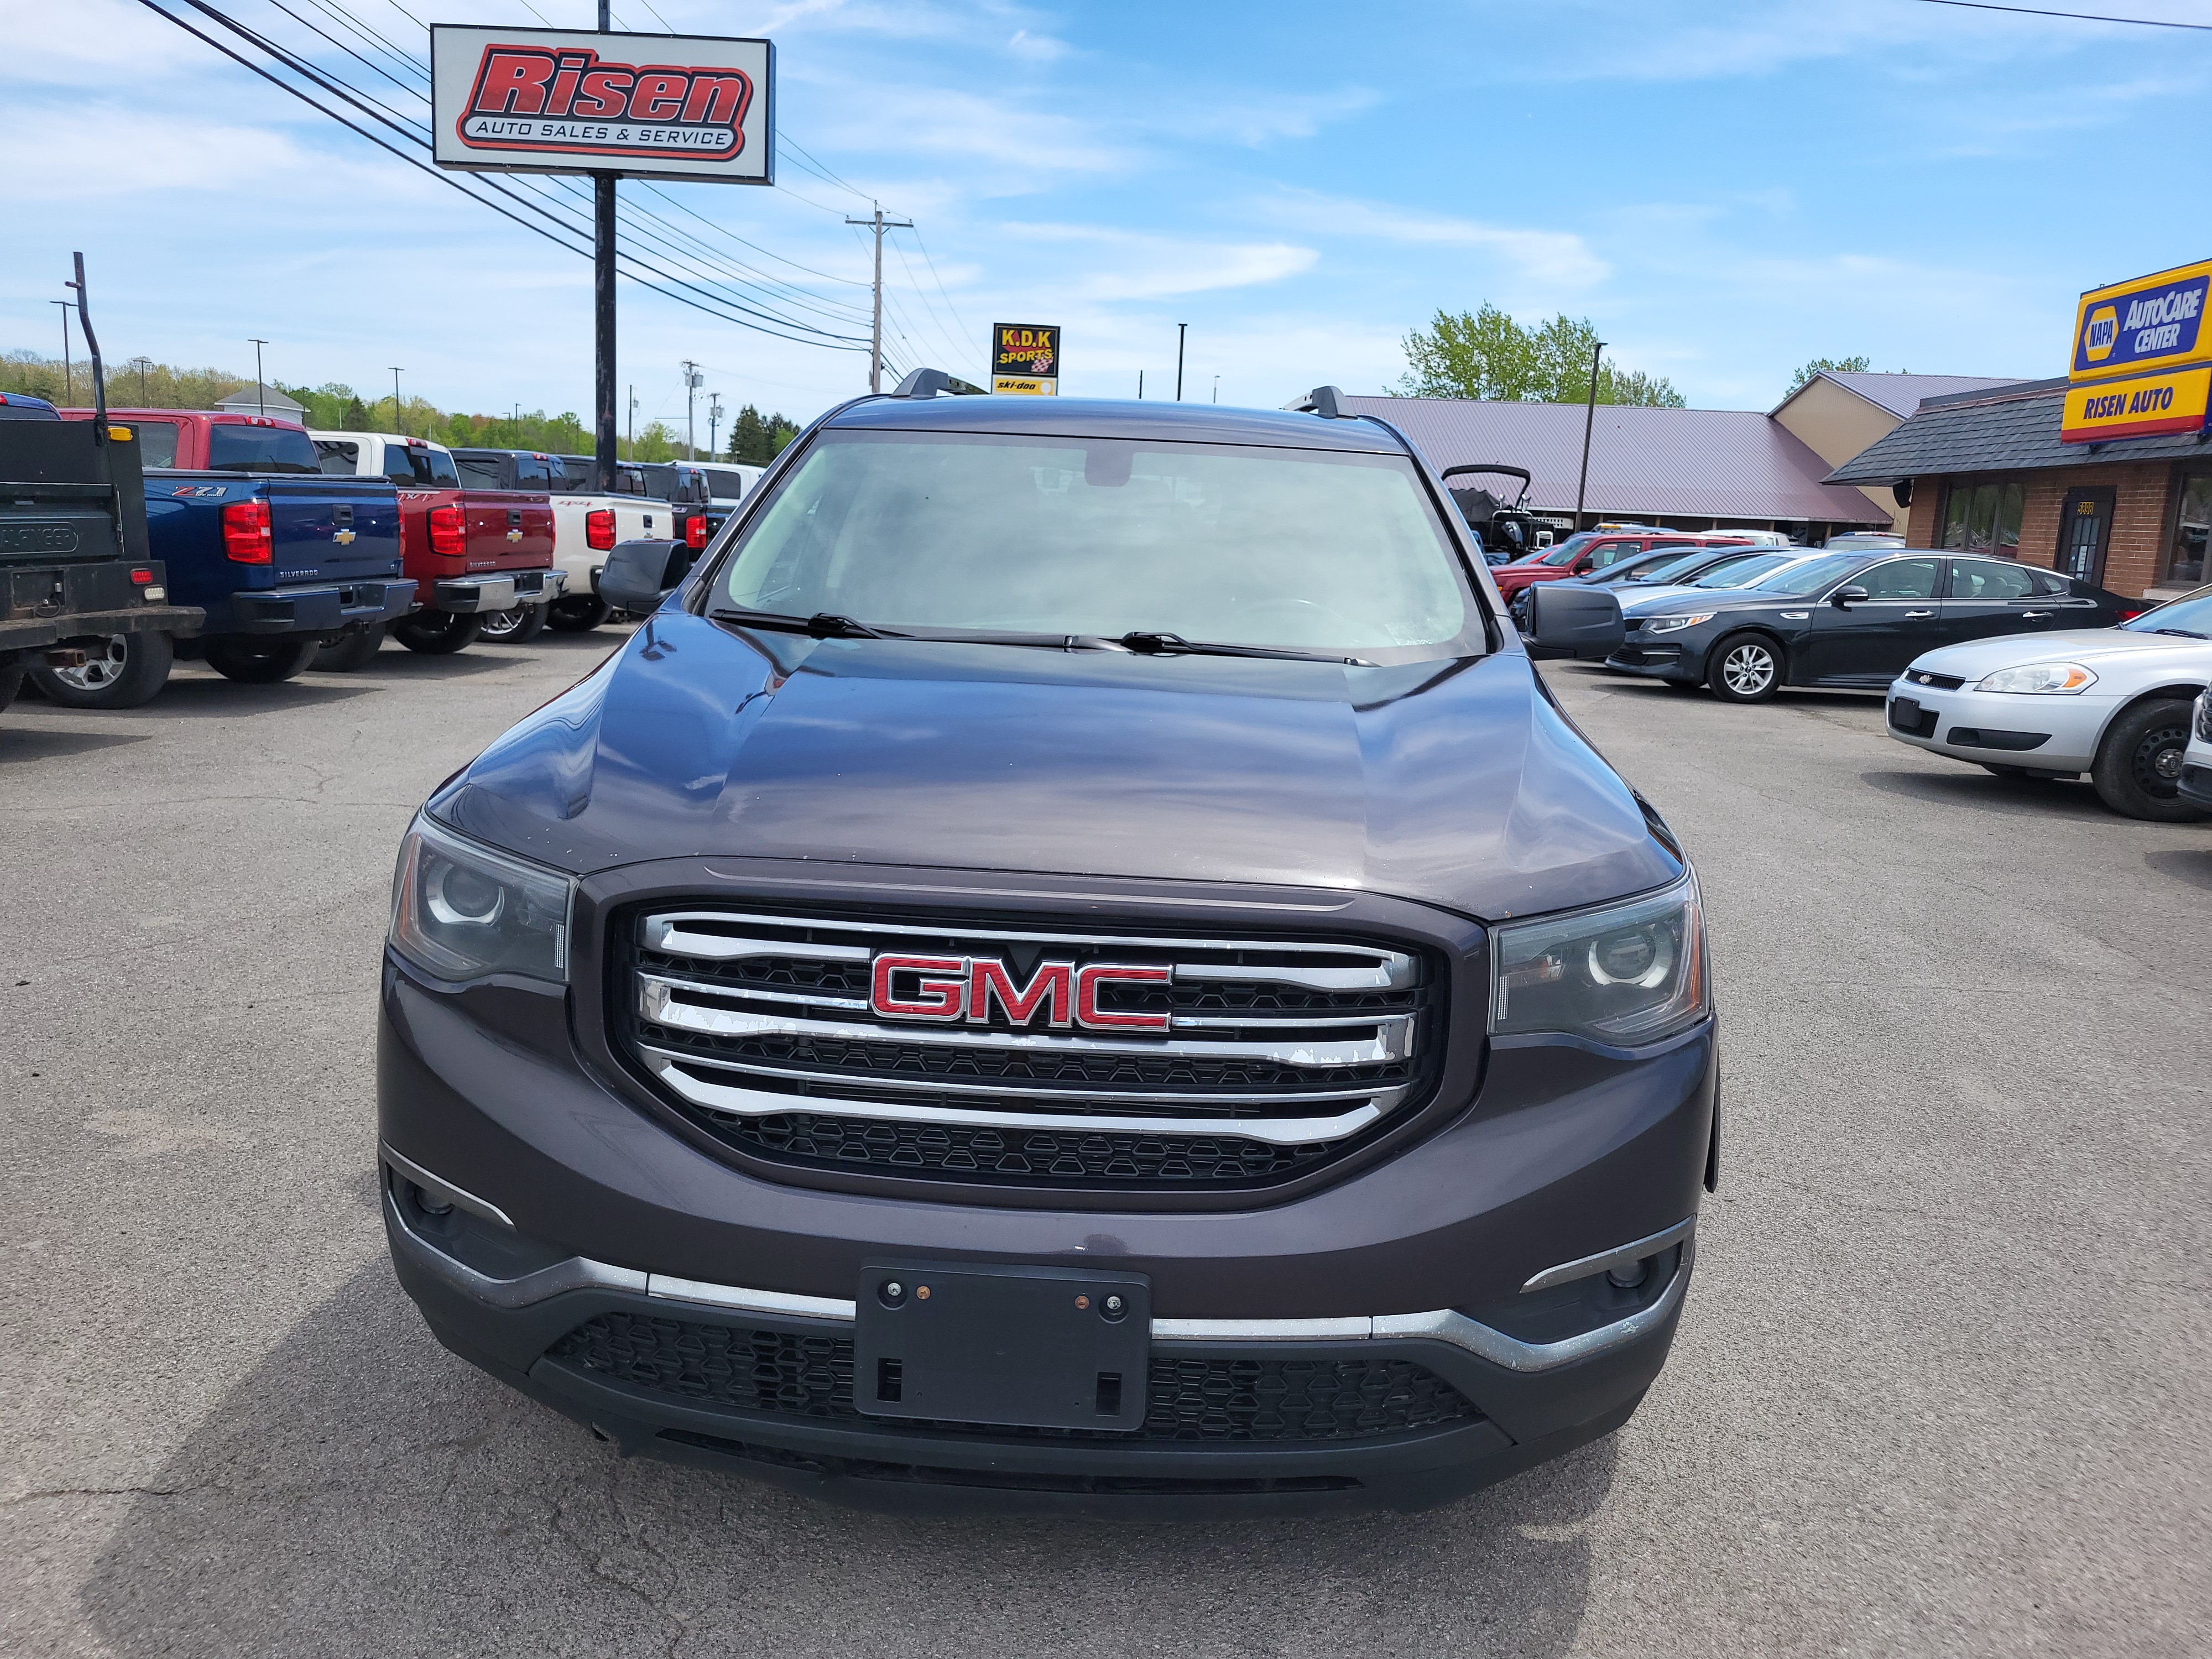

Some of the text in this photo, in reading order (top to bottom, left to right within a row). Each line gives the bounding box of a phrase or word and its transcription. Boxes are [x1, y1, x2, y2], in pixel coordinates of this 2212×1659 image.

[475, 54, 742, 123] Risen
[476, 121, 729, 145] AUTO SALES & SERVICE
[2122, 288, 2202, 332] AUTOCARE
[1002, 329, 1051, 348] K.D.K
[2089, 320, 2114, 348] NAPA
[2134, 323, 2180, 353] CENTER
[999, 348, 1052, 364] SPORTS
[997, 381, 1036, 390] ski-doo
[2083, 387, 2173, 420] RISEN AUTO
[171, 486, 228, 497] Z71
[2078, 503, 2093, 514] 5898
[0, 529, 71, 547] ALFINGER
[280, 569, 319, 578] SILVERADO
[869, 952, 1173, 1032] GMC
